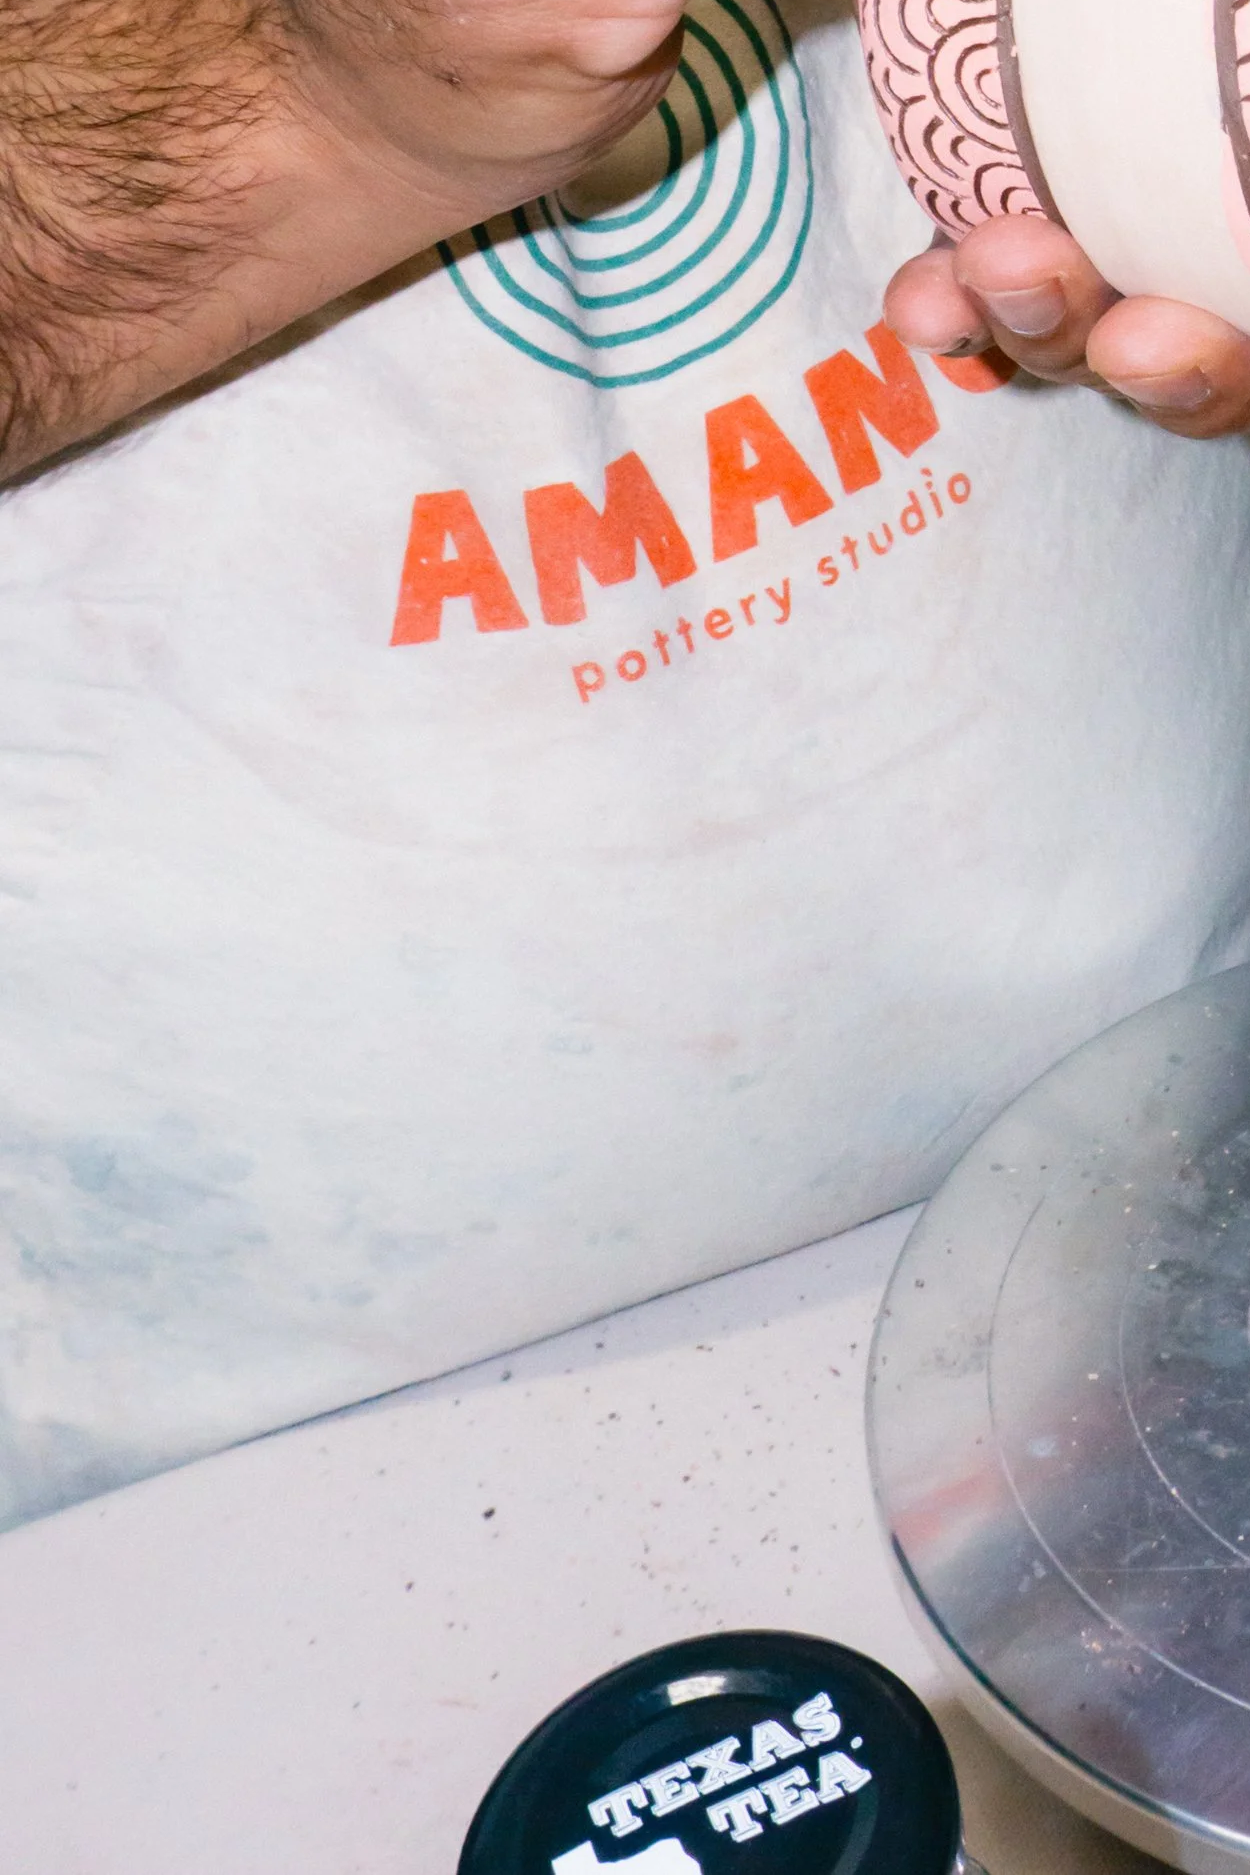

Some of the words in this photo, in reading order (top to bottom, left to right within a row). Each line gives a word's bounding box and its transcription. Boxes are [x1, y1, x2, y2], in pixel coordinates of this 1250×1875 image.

[572, 577, 791, 703] pottery
[817, 467, 972, 586] studio
[588, 1692, 841, 1837] TEXAS
[706, 1751, 872, 1842] TEA
